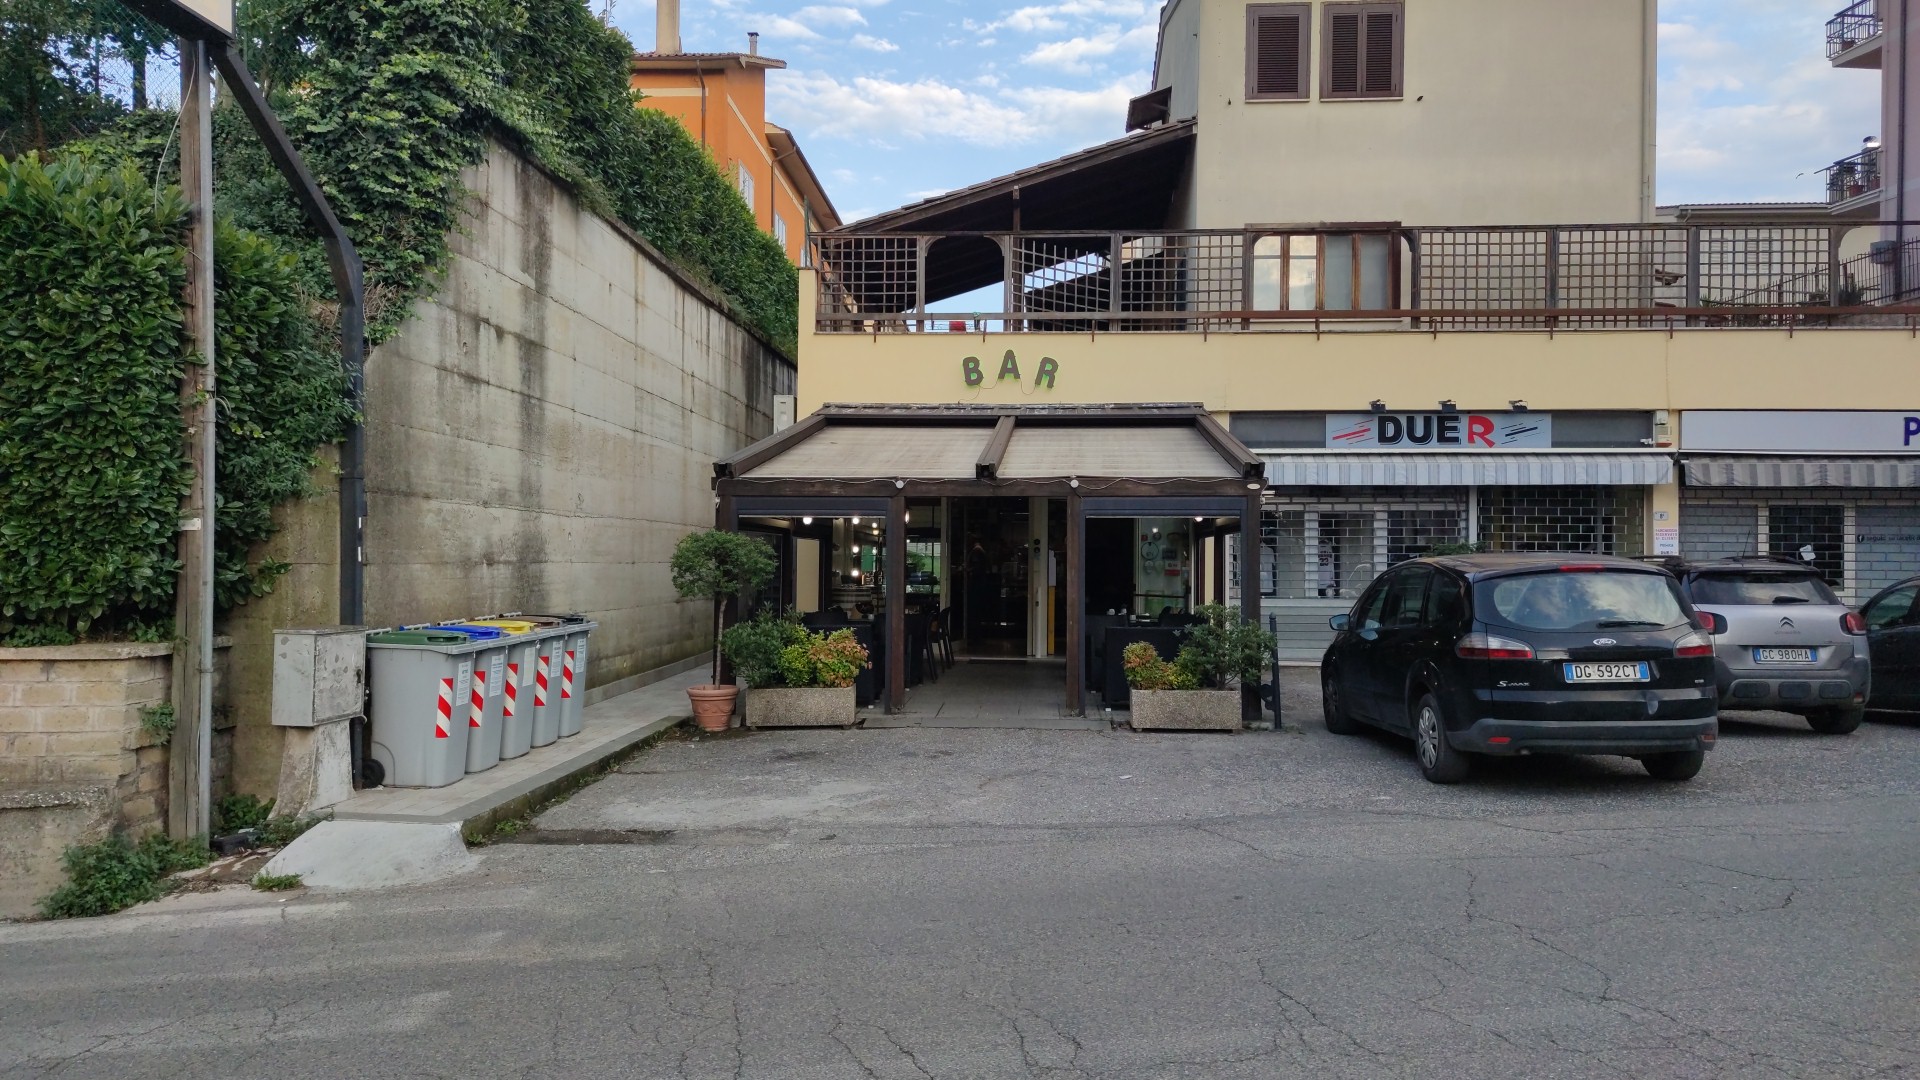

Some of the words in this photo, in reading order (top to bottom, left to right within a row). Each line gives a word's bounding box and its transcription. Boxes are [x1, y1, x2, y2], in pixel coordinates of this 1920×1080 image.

[962, 349, 1059, 389] BAR
[1761, 648, 1775, 660] GC
[1777, 648, 1810, 660] 980HA
[1574, 664, 1592, 679] DG
[1596, 663, 1638, 678] 592CT
